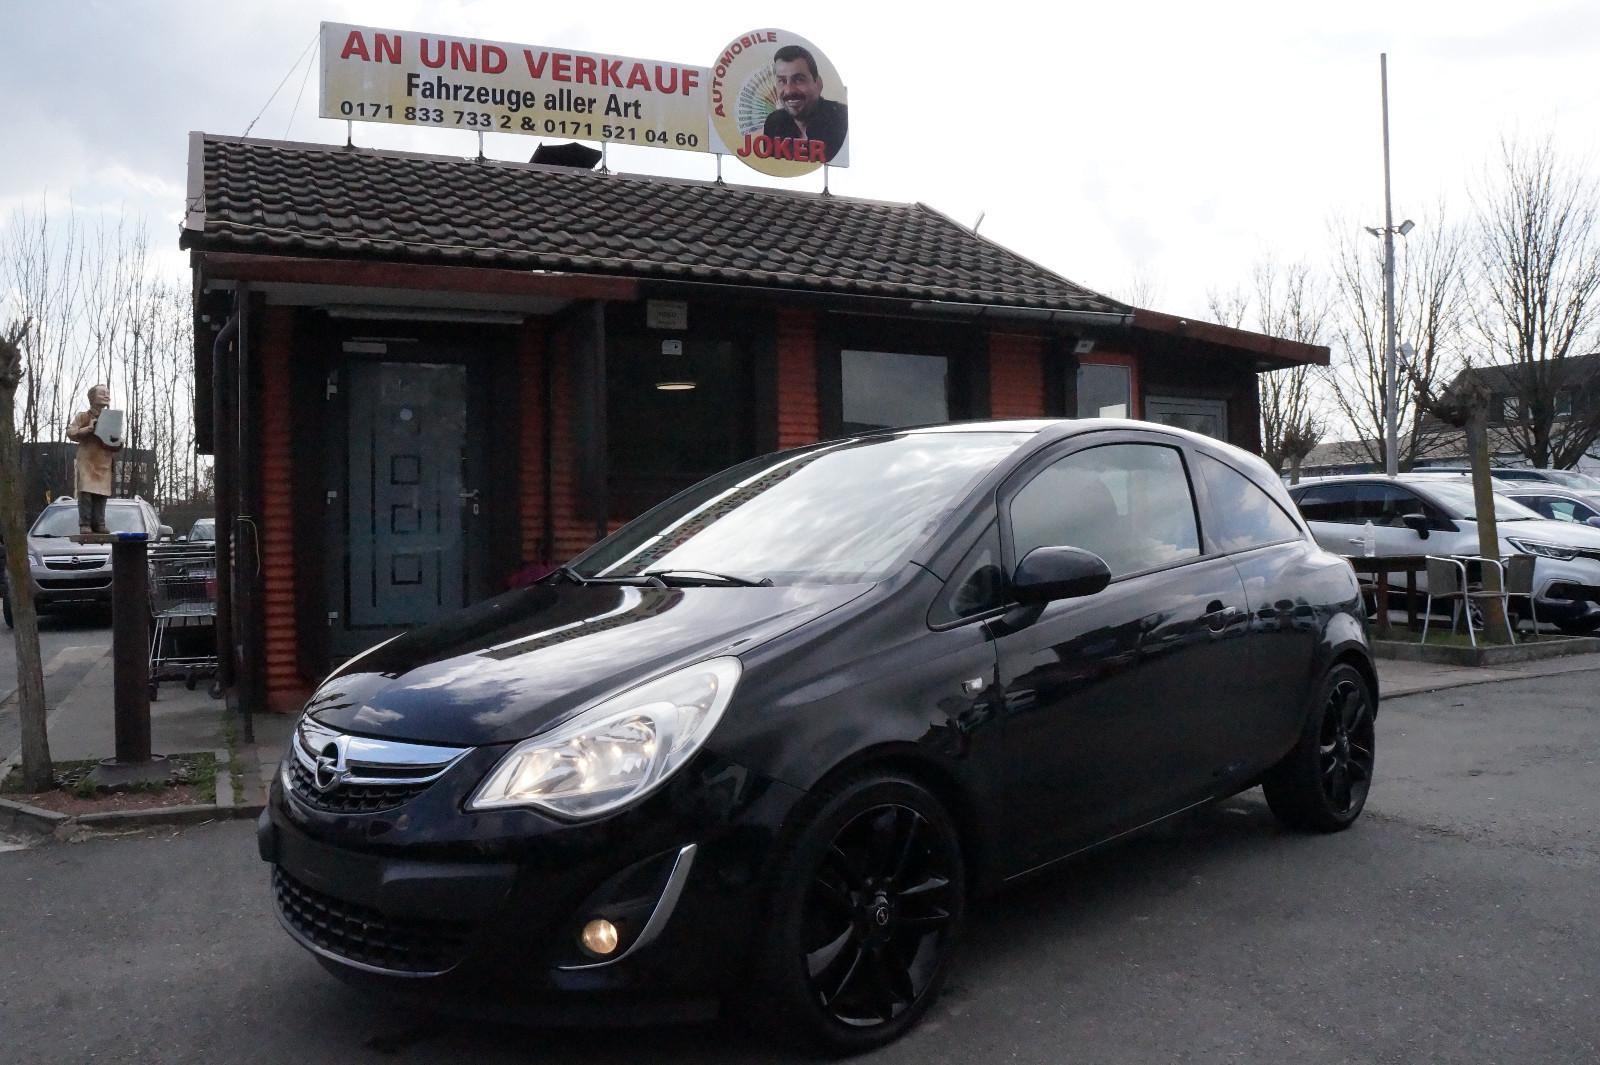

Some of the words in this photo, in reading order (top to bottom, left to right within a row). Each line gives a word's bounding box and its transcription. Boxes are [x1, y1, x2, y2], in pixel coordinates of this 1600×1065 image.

[340, 30, 402, 65] AN
[420, 38, 507, 74] UND
[523, 49, 699, 96] VERKAUF
[711, 31, 777, 118] AUTOMOBILE
[406, 72, 535, 113] Fahrzeuge
[543, 88, 596, 114] aller
[604, 93, 642, 120] Art
[340, 101, 393, 119] 0171
[404, 106, 444, 123] 833
[453, 111, 492, 127] 733
[500, 114, 512, 129] 2
[520, 116, 536, 131] &
[544, 119, 592, 136] 0171
[602, 124, 636, 141] 521
[645, 129, 668, 145] 04
[675, 132, 698, 147] 60
[736, 133, 827, 164] JOKER
